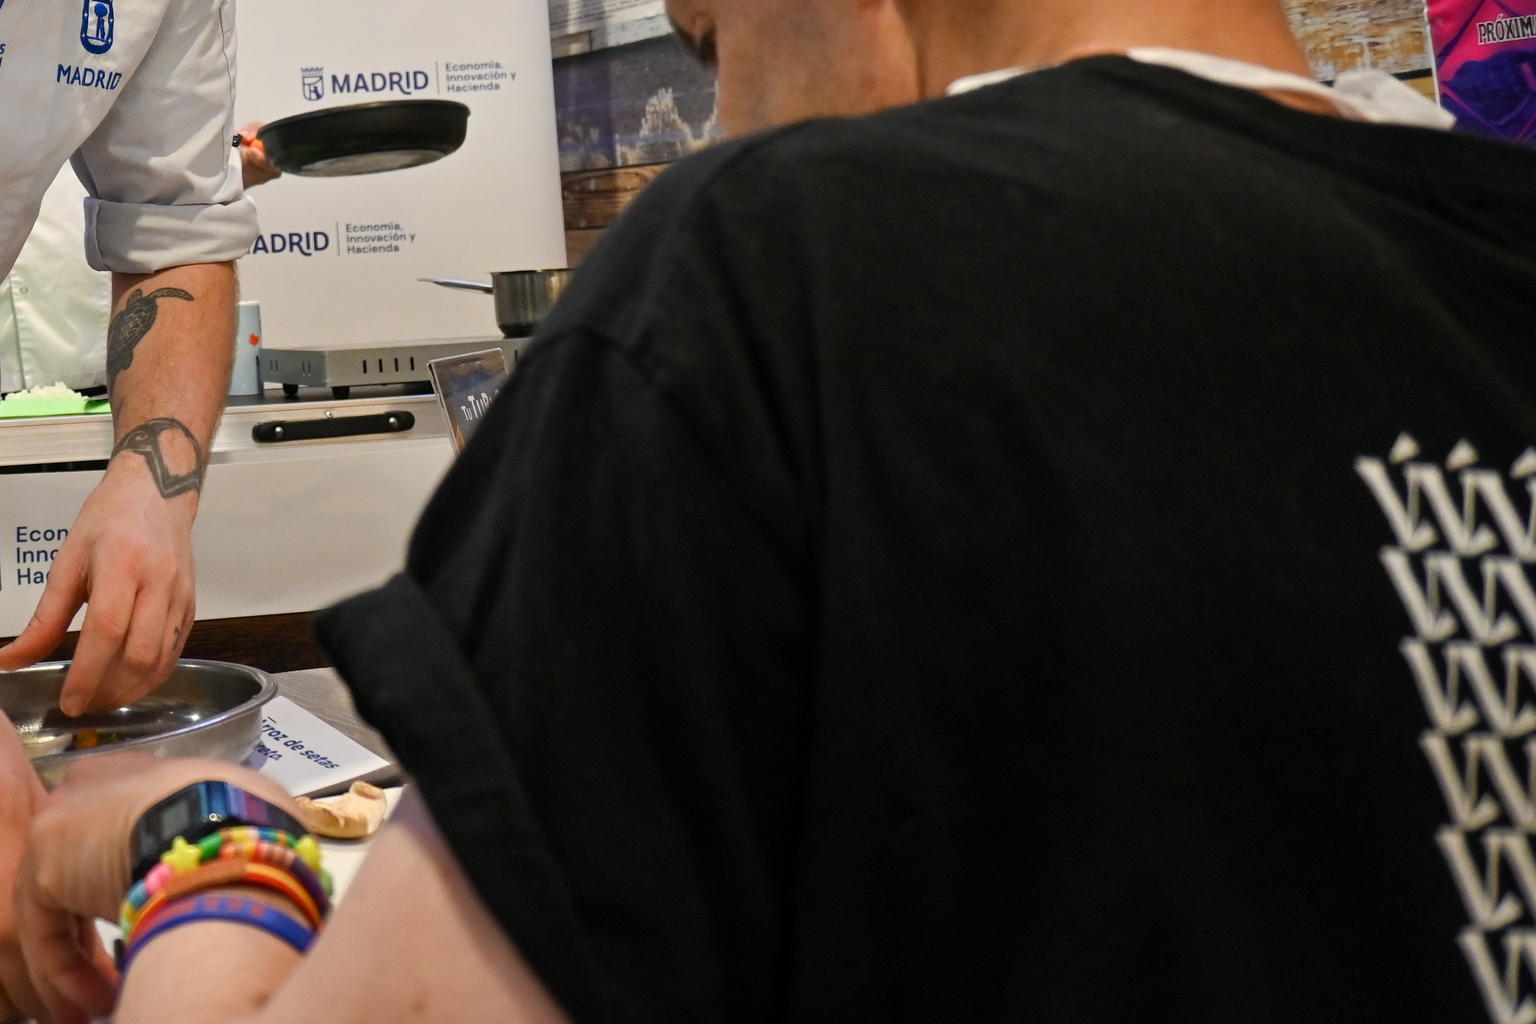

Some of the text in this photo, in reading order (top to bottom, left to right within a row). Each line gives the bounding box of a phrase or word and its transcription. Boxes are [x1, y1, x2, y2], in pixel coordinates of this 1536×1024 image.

[1476, 14, 1536, 45] PRÓXIM
[57, 63, 123, 90] MADRID
[331, 70, 429, 95] MADRID
[446, 71, 517, 81] Innovación y
[447, 81, 500, 93] Hacienda
[247, 231, 330, 257] ADRID
[346, 233, 416, 244] Innovación y
[347, 243, 400, 255] Hacienda
[17, 568, 50, 585] Ha
[262, 719, 340, 769] rroz de setas
